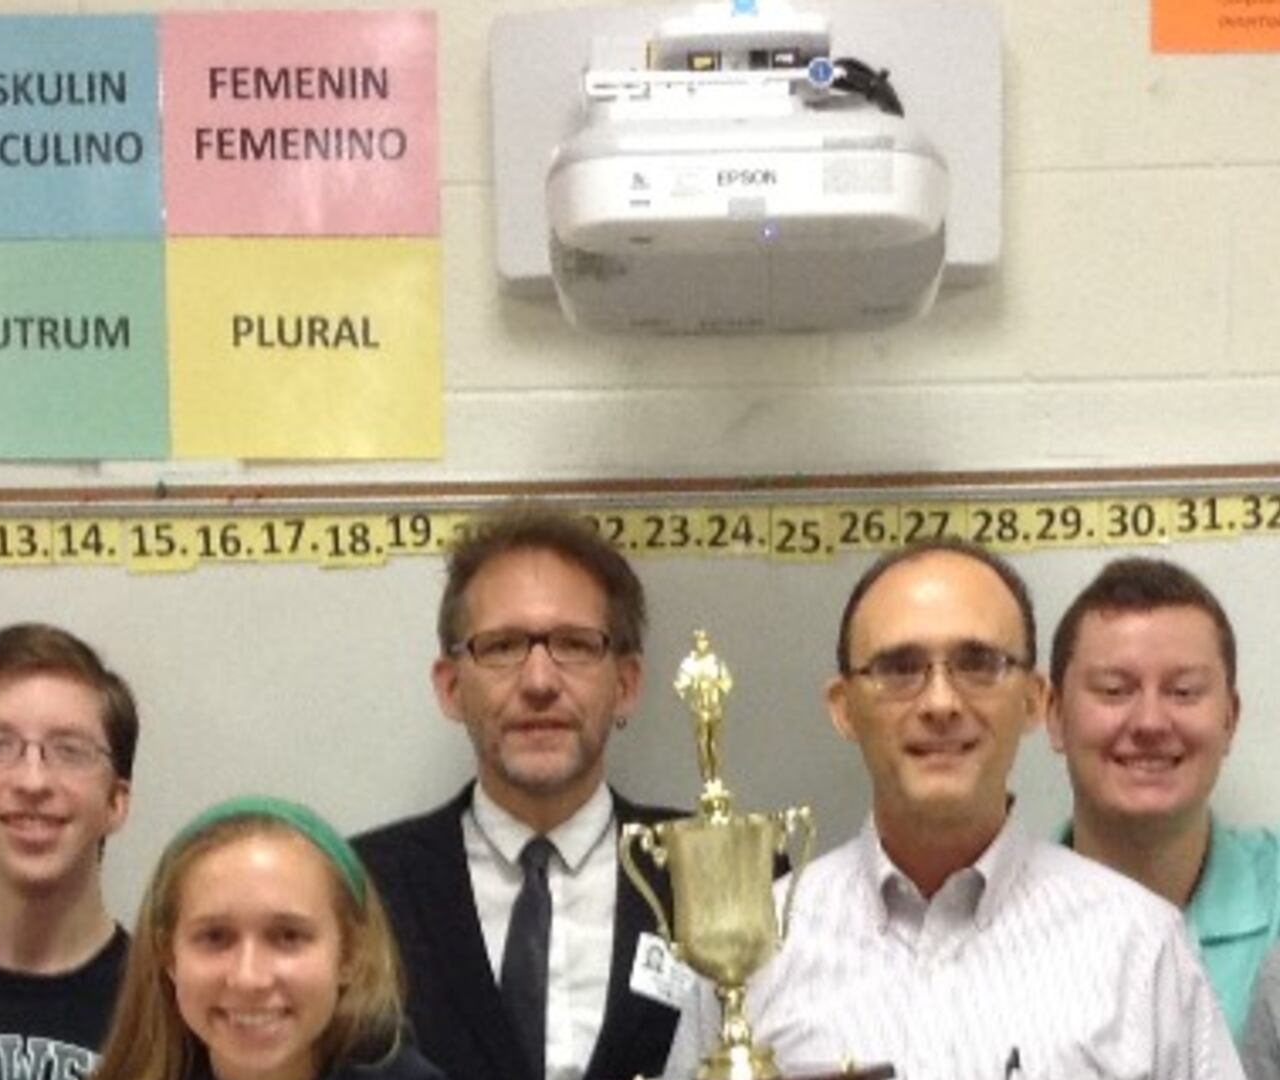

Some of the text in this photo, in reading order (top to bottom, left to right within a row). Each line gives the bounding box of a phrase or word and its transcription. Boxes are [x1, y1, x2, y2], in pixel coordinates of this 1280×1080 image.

[208, 67, 389, 100] FEMENIN
[195, 127, 407, 162] FEMENINO
[716, 169, 777, 187] EPSON
[233, 315, 379, 348] PLURAL
[59, 524, 116, 557] 14.
[131, 524, 188, 557] 15.
[197, 524, 253, 557] 16.
[260, 522, 319, 553] 17.
[326, 525, 383, 557] 18.
[387, 515, 444, 548] 19.
[646, 516, 703, 547] 23.
[708, 514, 766, 546] 24.
[776, 521, 834, 554] 25.
[839, 510, 897, 543] 26.
[903, 511, 960, 544] 27.
[973, 510, 1031, 543] 28.
[1036, 508, 1094, 540] 29.
[1107, 504, 1165, 537] 30.
[1177, 500, 1235, 532] 31.
